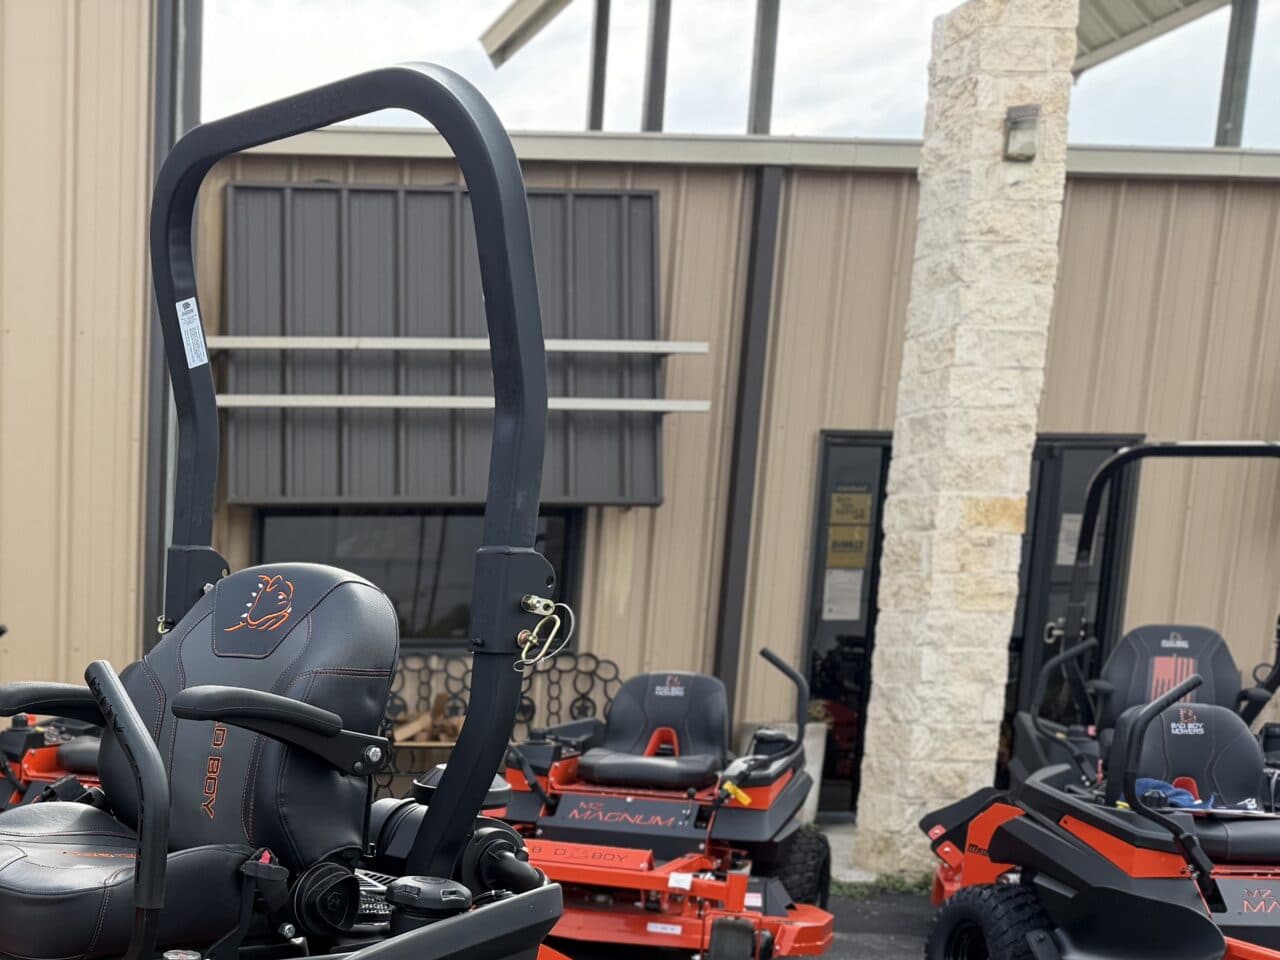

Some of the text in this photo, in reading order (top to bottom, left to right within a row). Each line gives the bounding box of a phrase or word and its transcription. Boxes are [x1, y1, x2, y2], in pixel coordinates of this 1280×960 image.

[202, 756, 222, 818] BOY
[568, 808, 676, 827] MAGNUM
[590, 851, 629, 862] BOY
